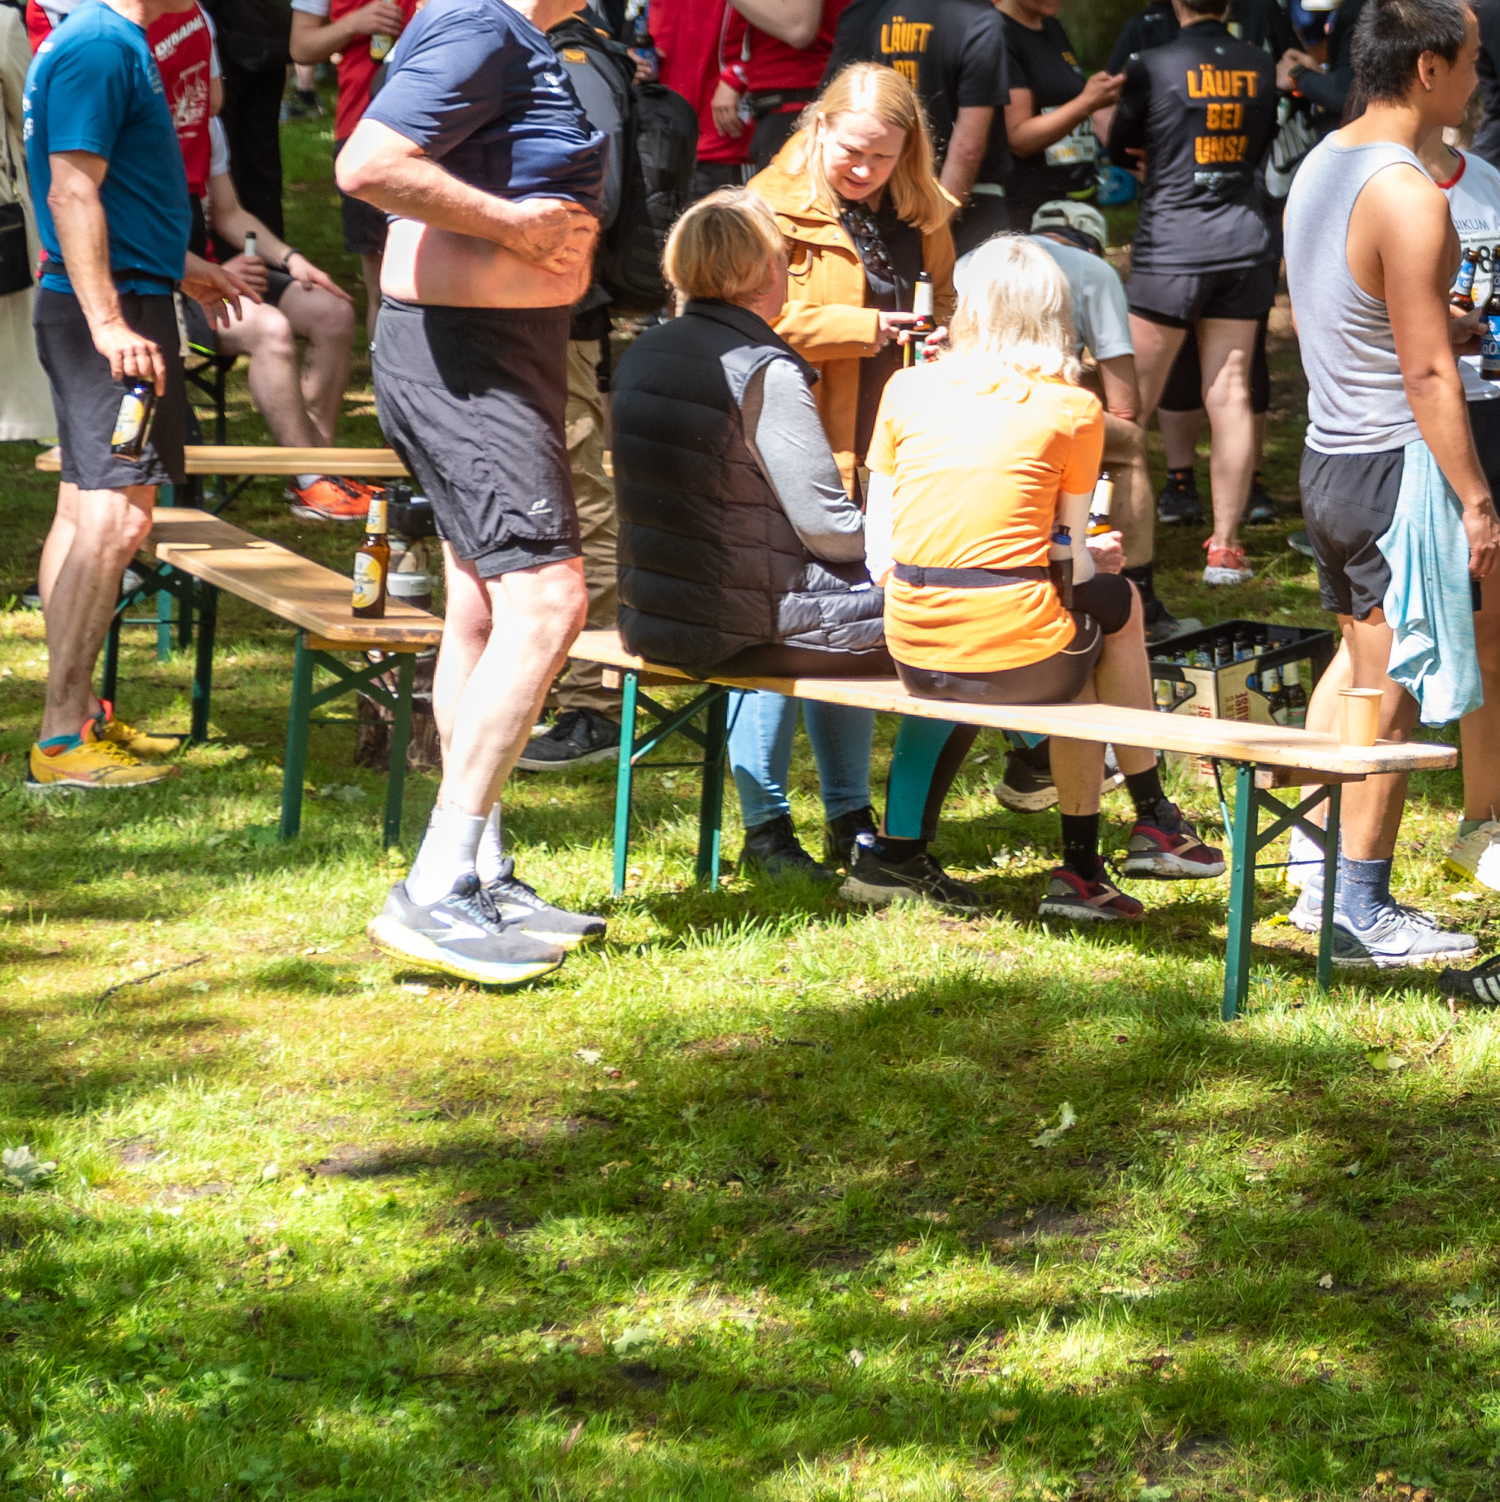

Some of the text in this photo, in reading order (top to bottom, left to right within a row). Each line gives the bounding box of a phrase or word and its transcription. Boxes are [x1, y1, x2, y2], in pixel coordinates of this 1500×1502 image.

[881, 16, 933, 54] LÄUFT
[1187, 64, 1258, 98] LÄUFT
[1206, 103, 1244, 130] BEI
[1195, 136, 1247, 164] UNS!
